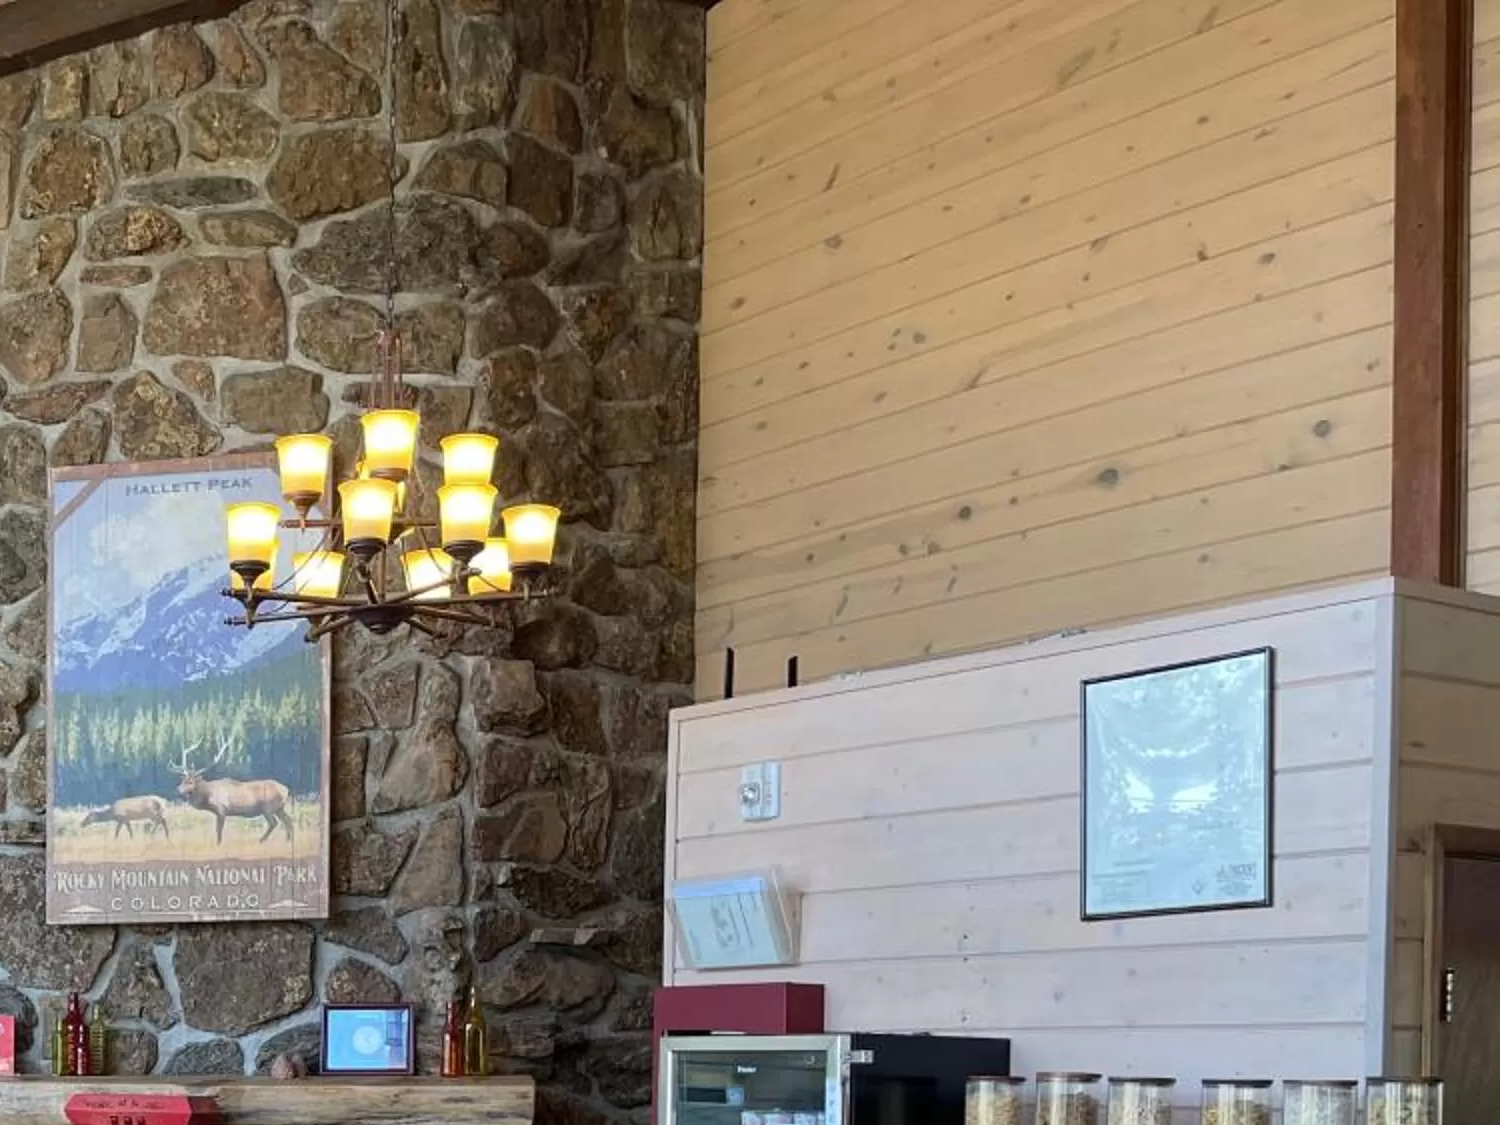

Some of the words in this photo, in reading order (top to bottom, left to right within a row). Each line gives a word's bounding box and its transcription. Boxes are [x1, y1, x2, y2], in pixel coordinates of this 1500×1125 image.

[126, 480, 201, 497] HALLETT
[207, 476, 253, 492] PEAK
[54, 870, 105, 893] ROCKY
[111, 866, 190, 890] MOUNTAIN
[195, 863, 266, 887] NATIONAL
[272, 863, 318, 887] PARK
[110, 894, 260, 911] COLORADO
